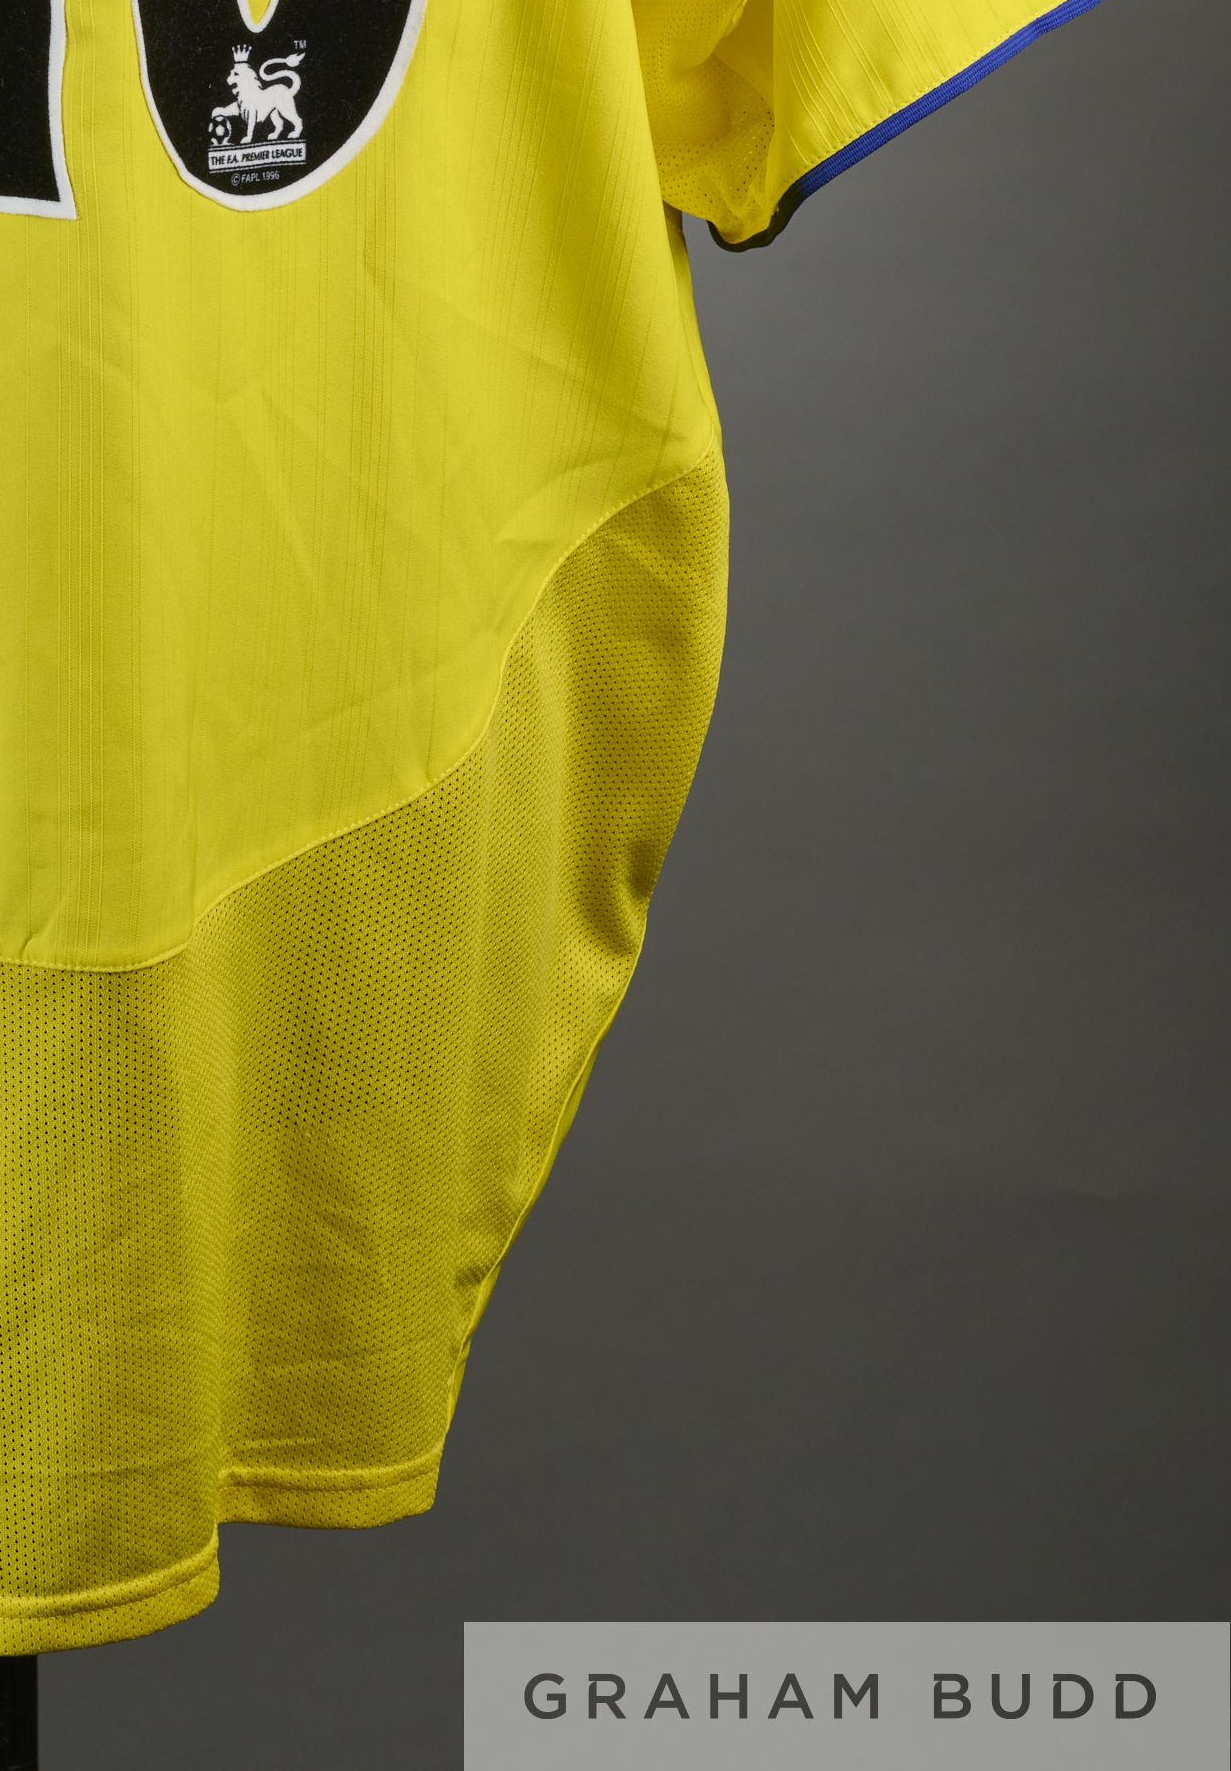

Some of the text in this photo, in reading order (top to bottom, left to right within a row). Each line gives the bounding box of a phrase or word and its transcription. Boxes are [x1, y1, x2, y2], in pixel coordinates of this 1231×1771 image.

[294, 40, 307, 50] TM
[211, 156, 226, 166] THE
[242, 151, 270, 163] PREMIER
[271, 147, 303, 160] LEAGUE
